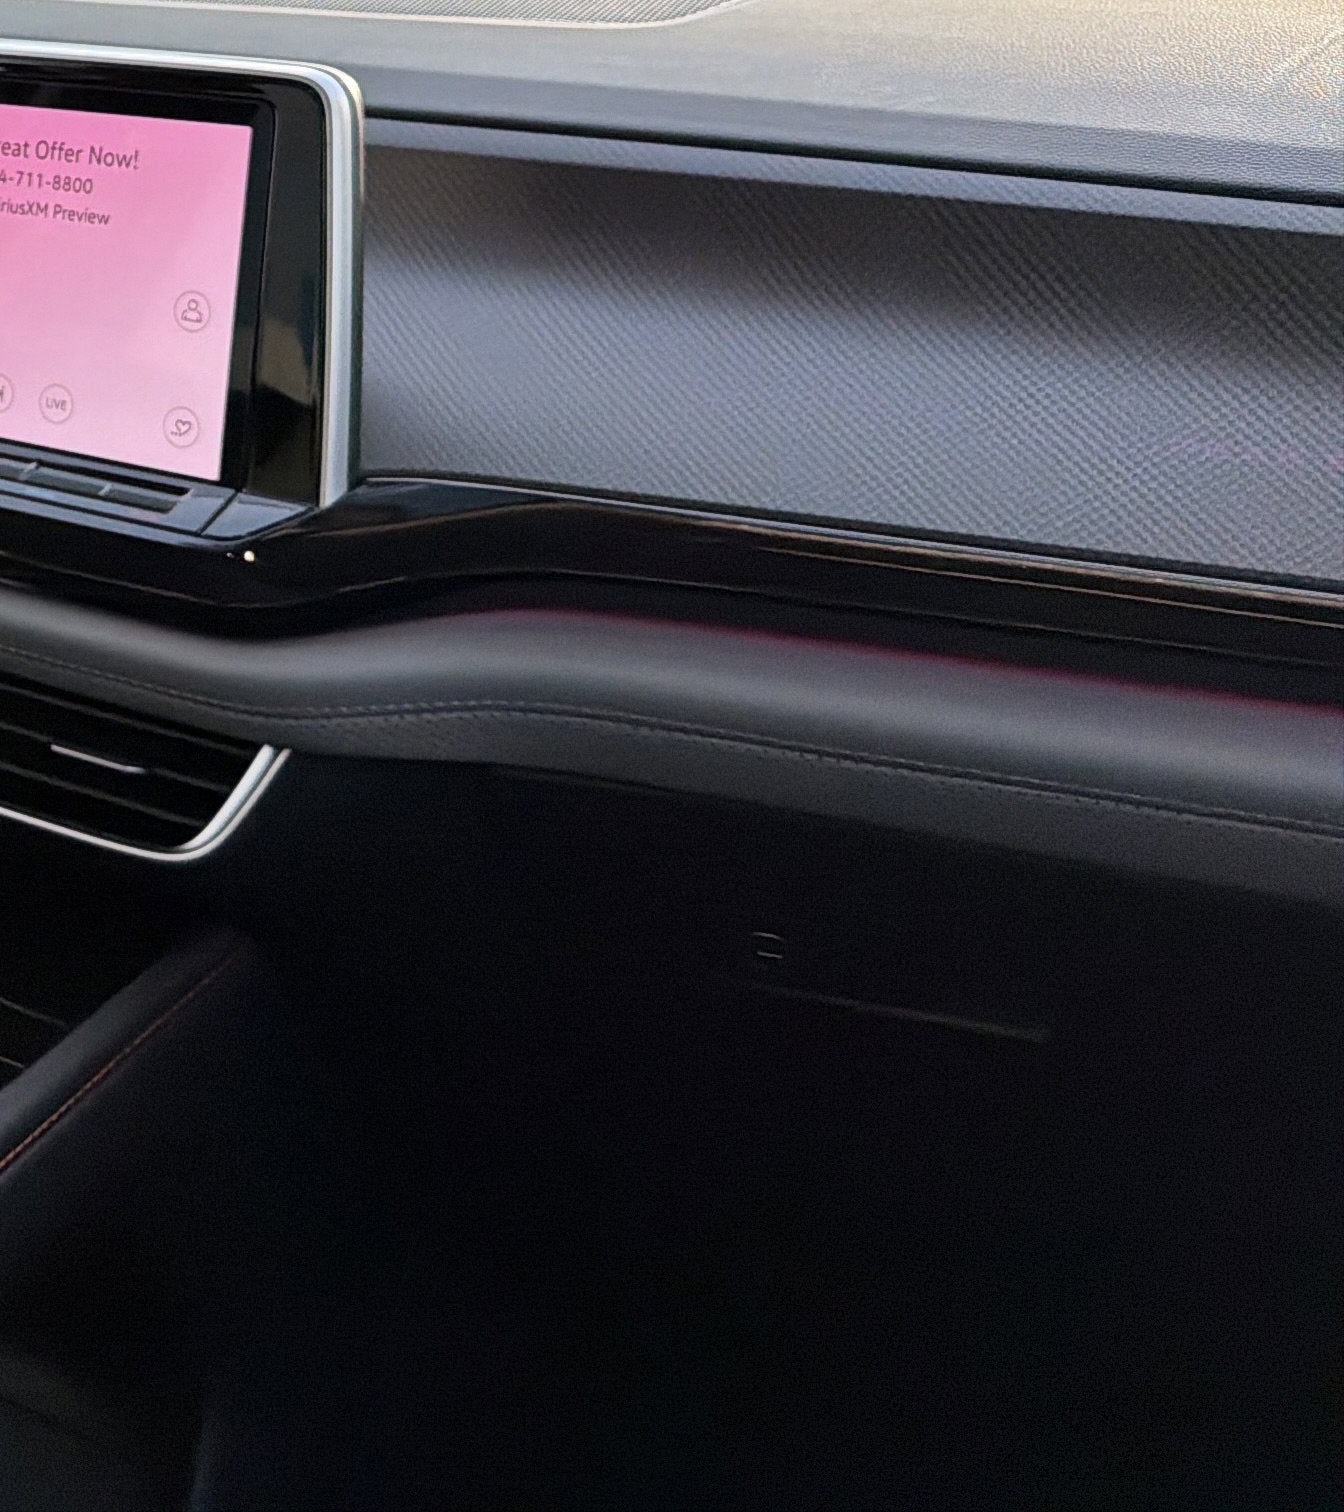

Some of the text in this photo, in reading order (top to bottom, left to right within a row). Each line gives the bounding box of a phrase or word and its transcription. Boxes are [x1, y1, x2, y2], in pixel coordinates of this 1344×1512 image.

[35, 139, 83, 165] Offer
[88, 146, 140, 171] Now!
[52, 205, 111, 227] Preview
[45, 397, 67, 412] LIVE
